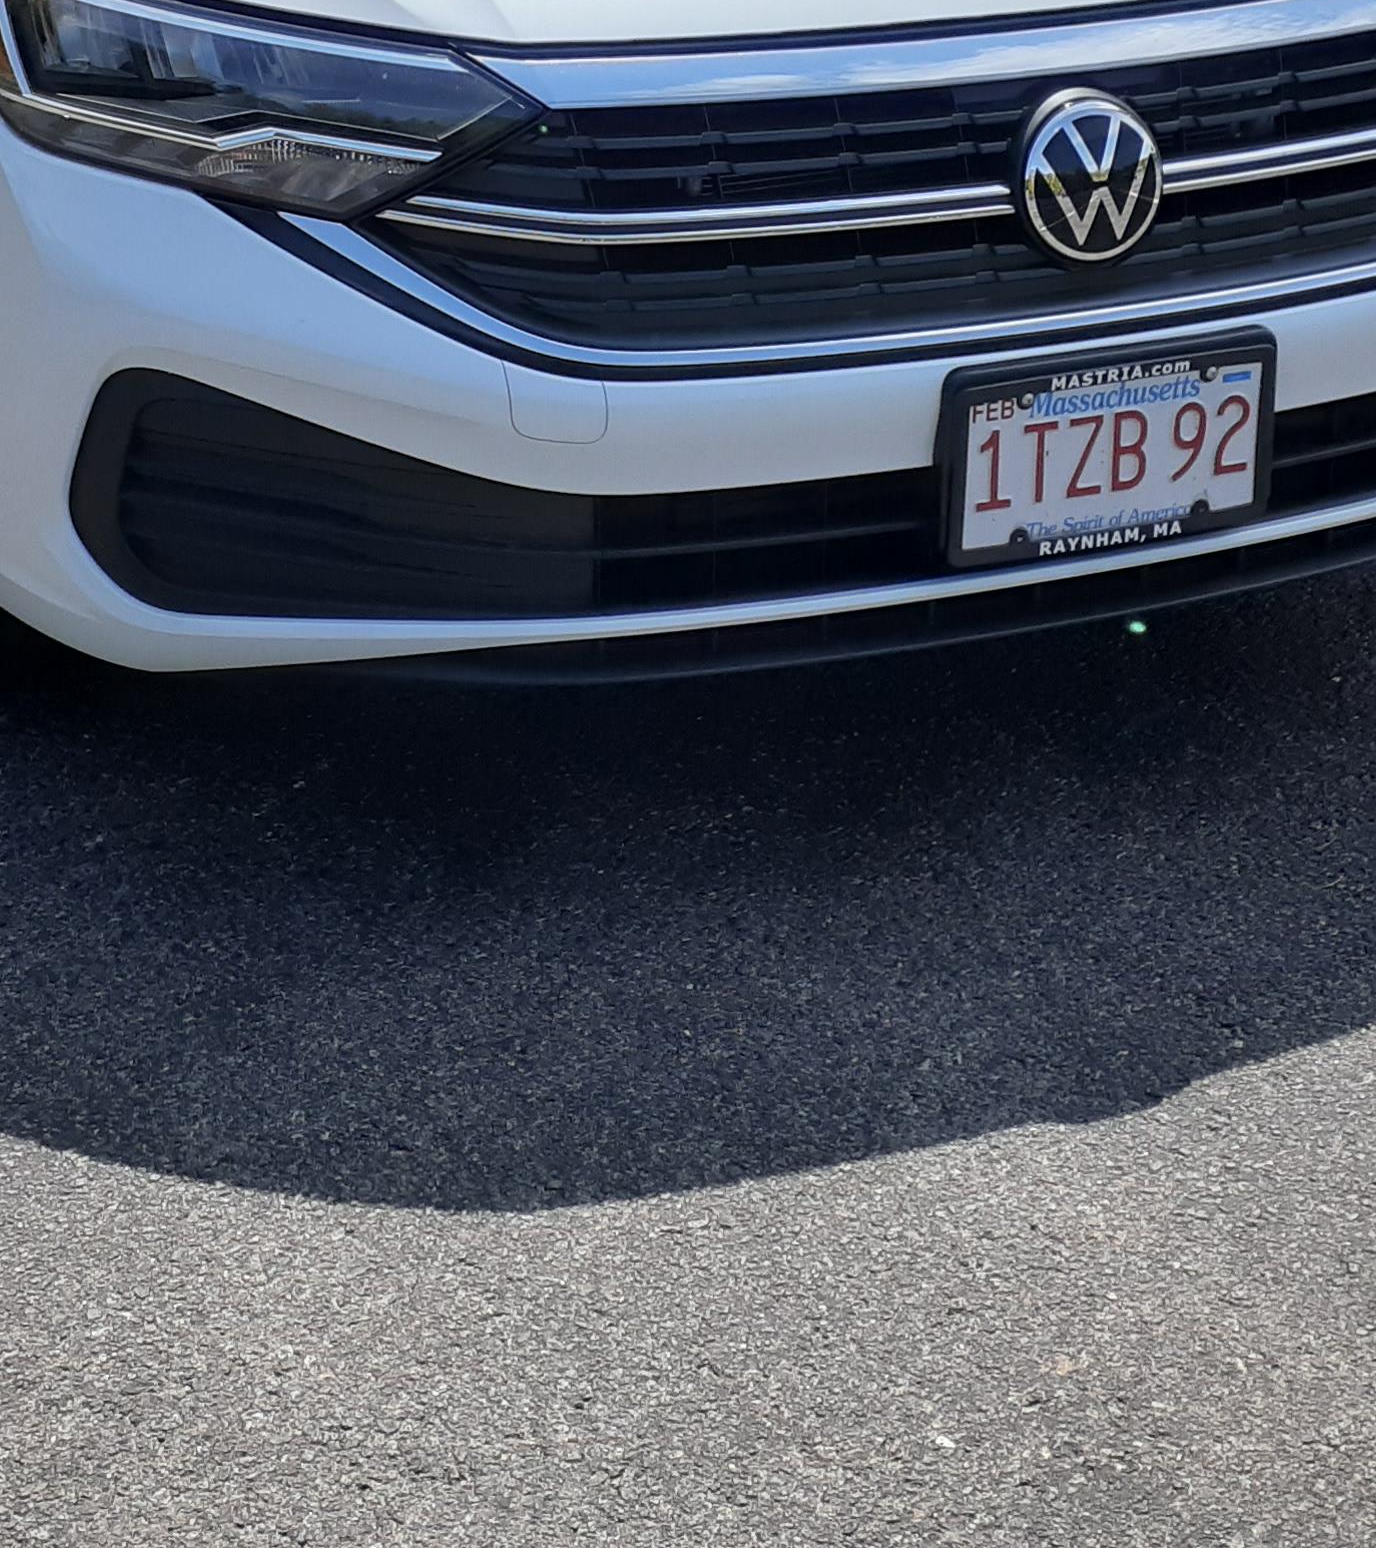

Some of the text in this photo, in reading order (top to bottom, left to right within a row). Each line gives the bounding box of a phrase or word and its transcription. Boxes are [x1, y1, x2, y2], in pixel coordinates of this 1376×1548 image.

[1030, 108, 1154, 248] VW
[1051, 360, 1191, 391] MASTRIA.com
[973, 399, 1015, 423] FEB
[1029, 378, 1201, 419] Massachusetts
[975, 395, 1251, 512] 1TZB 92
[1027, 521, 1058, 538] The
[1063, 515, 1104, 536] Spirit
[1108, 510, 1125, 528] of
[1039, 520, 1182, 556] RAYNHAM, MA
